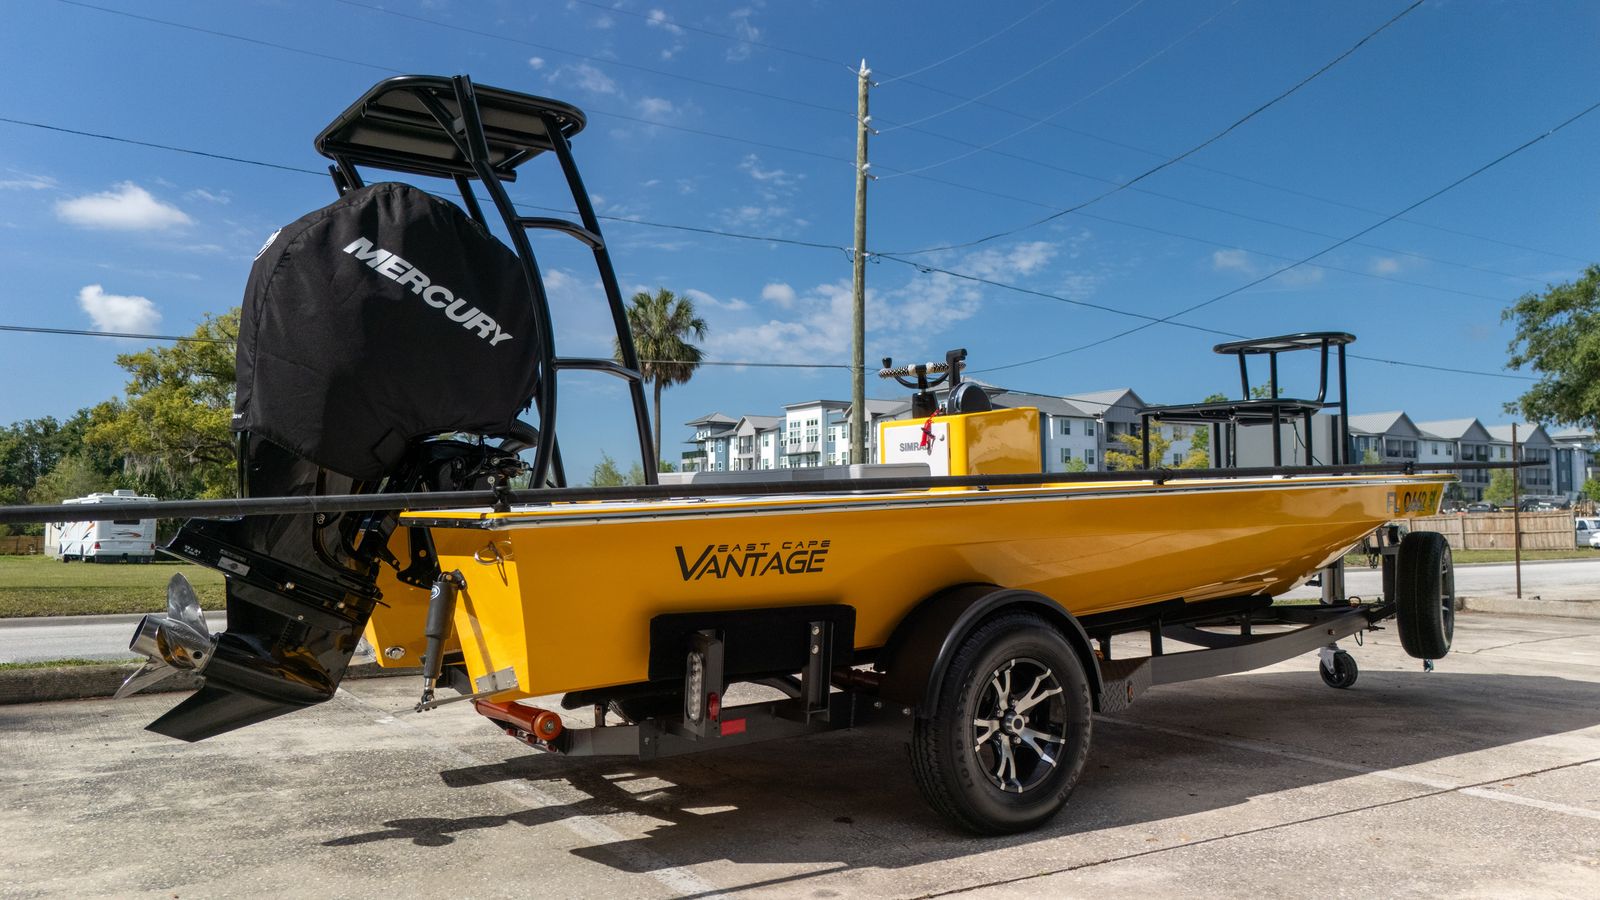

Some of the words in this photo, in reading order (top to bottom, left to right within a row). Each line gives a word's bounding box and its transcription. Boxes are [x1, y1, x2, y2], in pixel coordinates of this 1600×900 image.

[343, 236, 513, 347] MERCURY
[1387, 492, 1400, 513] FL
[717, 543, 771, 553] EAST
[782, 540, 831, 550] CAPE
[675, 544, 829, 582] VANTAGE
